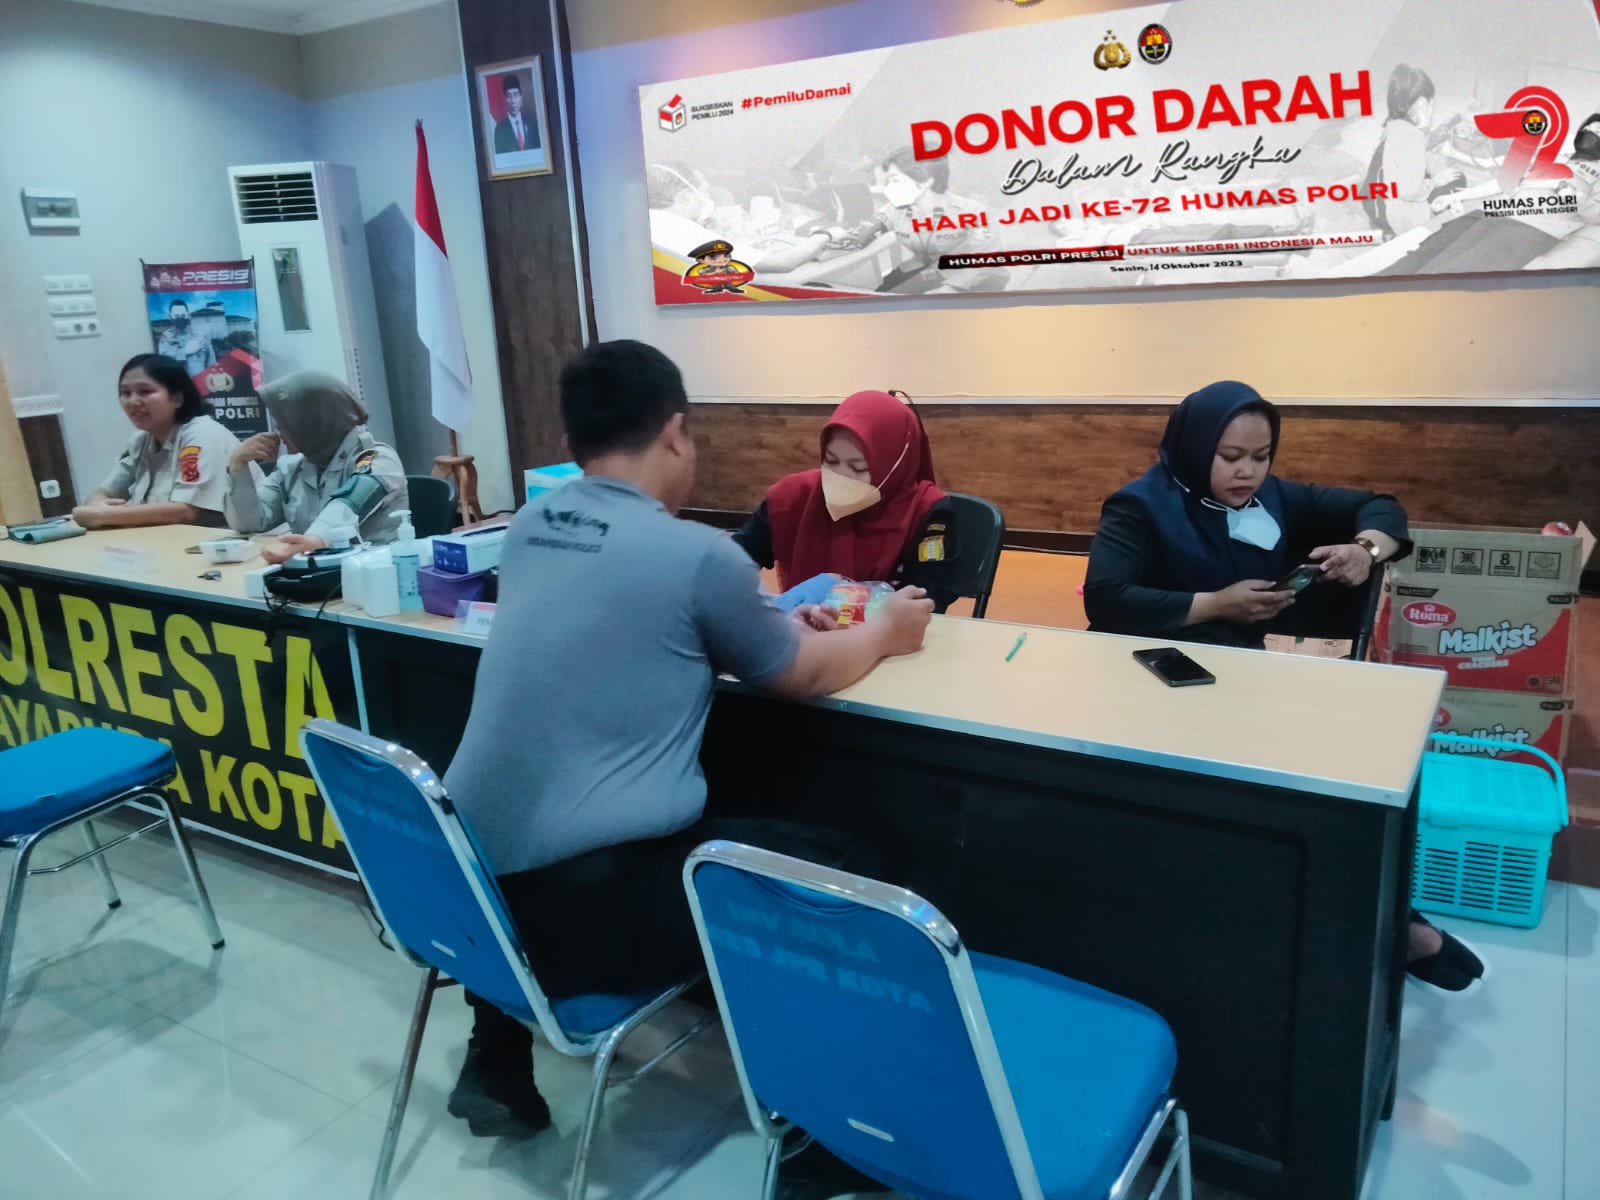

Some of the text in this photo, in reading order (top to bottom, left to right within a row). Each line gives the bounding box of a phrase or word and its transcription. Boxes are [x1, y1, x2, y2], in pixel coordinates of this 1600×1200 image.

[741, 82, 852, 109] #PemiluDamai
[691, 101, 734, 113] SUKSESKAN
[691, 108, 734, 121] PEMILU 2024
[910, 70, 1374, 162] DONOR DARAH
[1001, 136, 1302, 196] Dalam Rangka
[912, 182, 1399, 233] HARI JADI KE-72 HUMAS POLRI
[1483, 195, 1577, 210] HUMAS POLRI
[1484, 206, 1578, 218] PRESISI UNTUK NEGERI
[949, 235, 1374, 266] HUMAS POLRI PRESISI UNTUK NEGERI INDONESIA MAJU
[1160, 261, 1211, 270] Oktober
[1212, 260, 1244, 268] 2023
[215, 407, 260, 420] POLRI
[1410, 608, 1449, 623] Roma
[1438, 619, 1538, 655] Malkist
